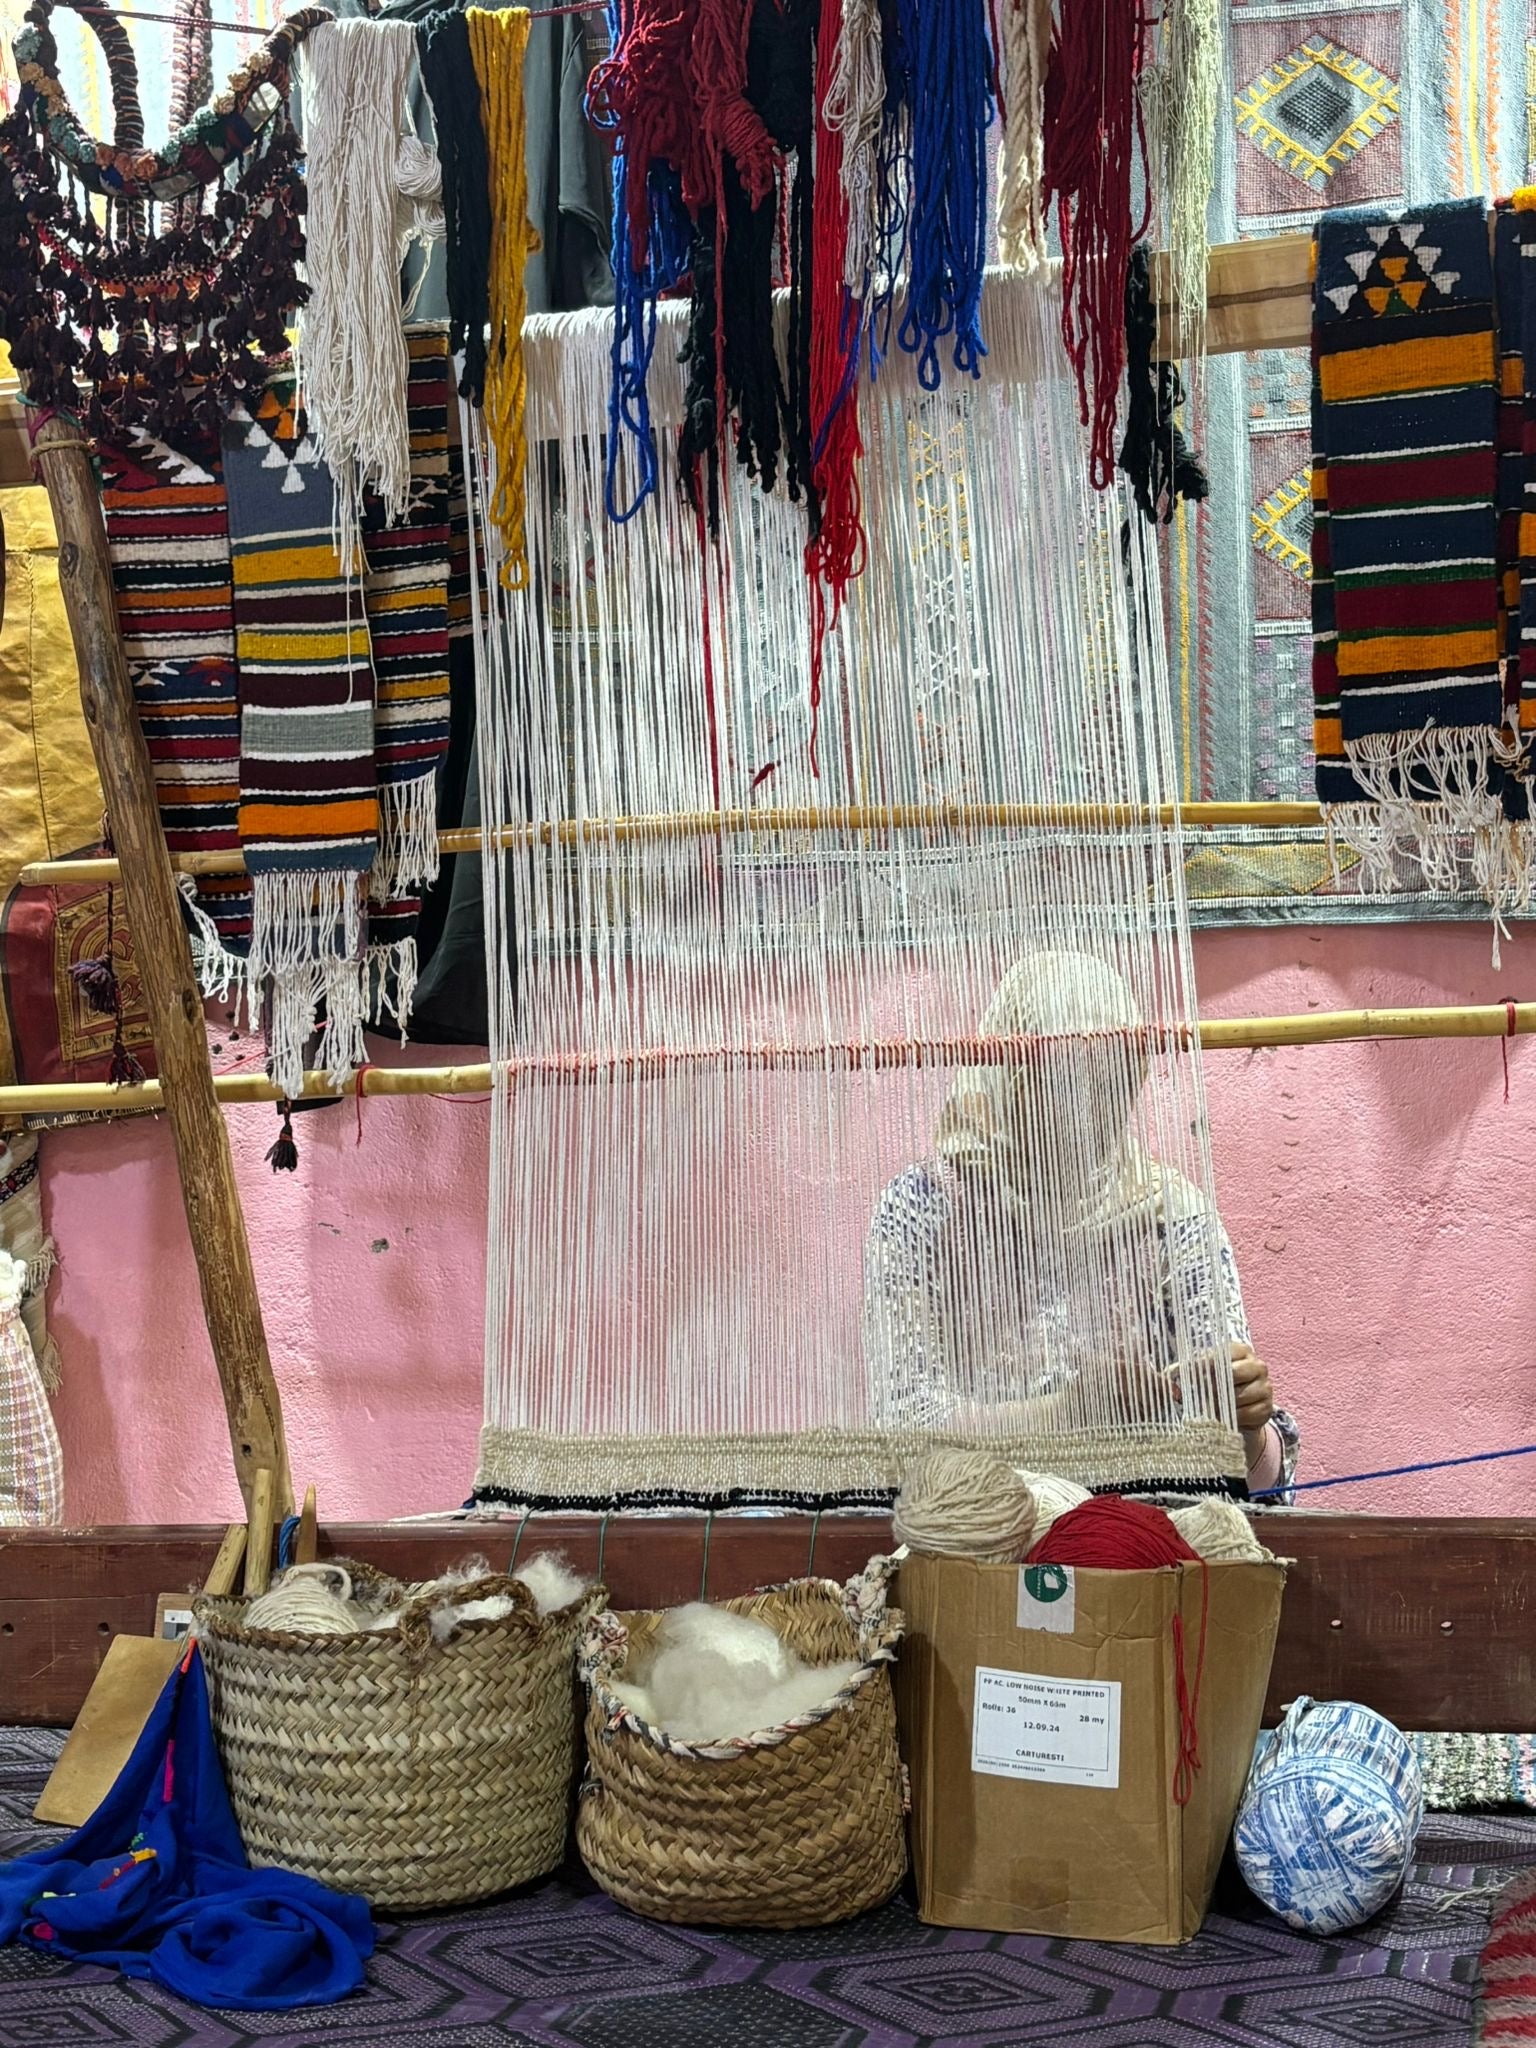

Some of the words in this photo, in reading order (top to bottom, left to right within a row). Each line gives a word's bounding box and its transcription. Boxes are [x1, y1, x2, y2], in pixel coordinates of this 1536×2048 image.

[1024, 1684, 1045, 1692] NOISE
[1073, 1690, 1105, 1698] PRINTED
[1018, 1696, 1042, 1705] 50mm
[982, 1702, 1004, 1712] Rolls:
[1024, 1721, 1060, 1732] 12.09.24
[1015, 1749, 1065, 1762] CARTURESTI
